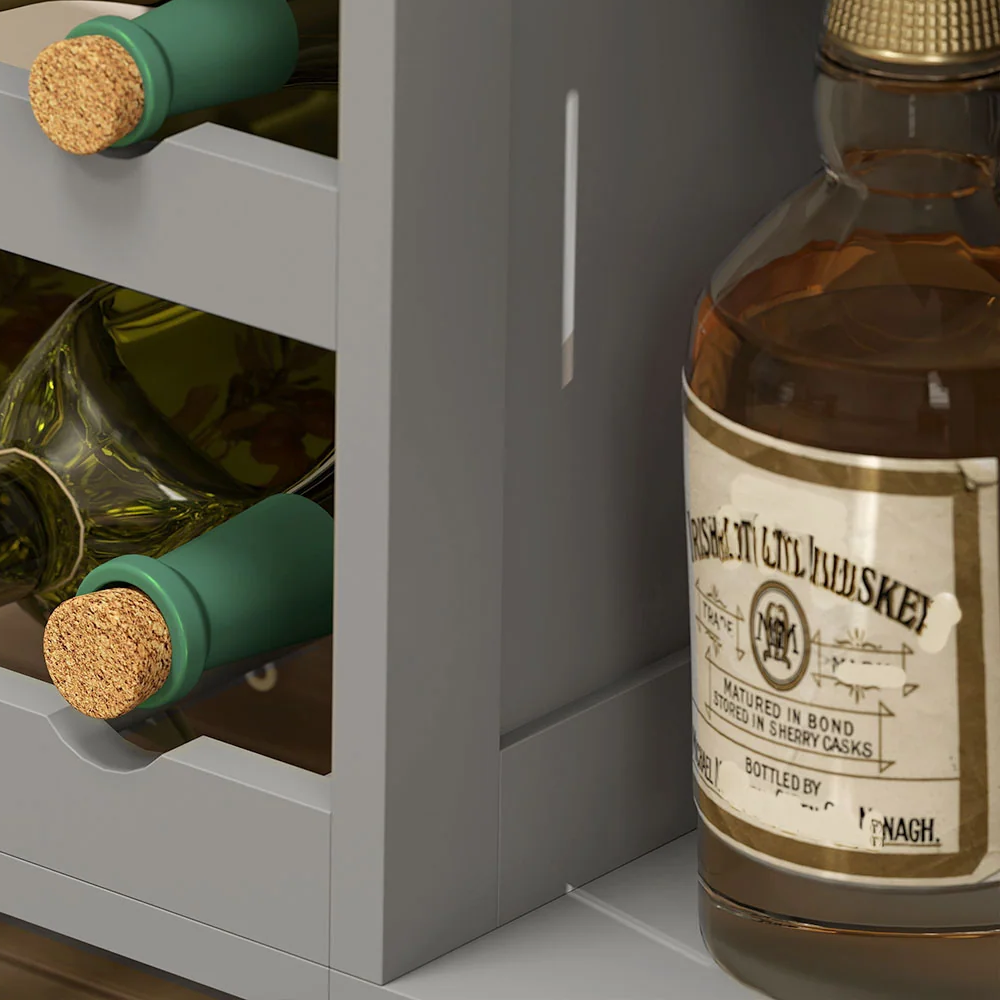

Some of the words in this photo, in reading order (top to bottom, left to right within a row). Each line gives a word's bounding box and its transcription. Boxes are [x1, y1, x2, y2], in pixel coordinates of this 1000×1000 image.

[713, 690, 749, 725] STORED
[752, 715, 765, 733] IN
[769, 720, 820, 748] SHERRY
[822, 736, 873, 758] CASKS
[723, 677, 781, 719] MATURED
[787, 706, 801, 726] IN
[808, 713, 854, 737] BOND
[745, 755, 800, 792] BOTTLED
[803, 778, 822, 797] BY
